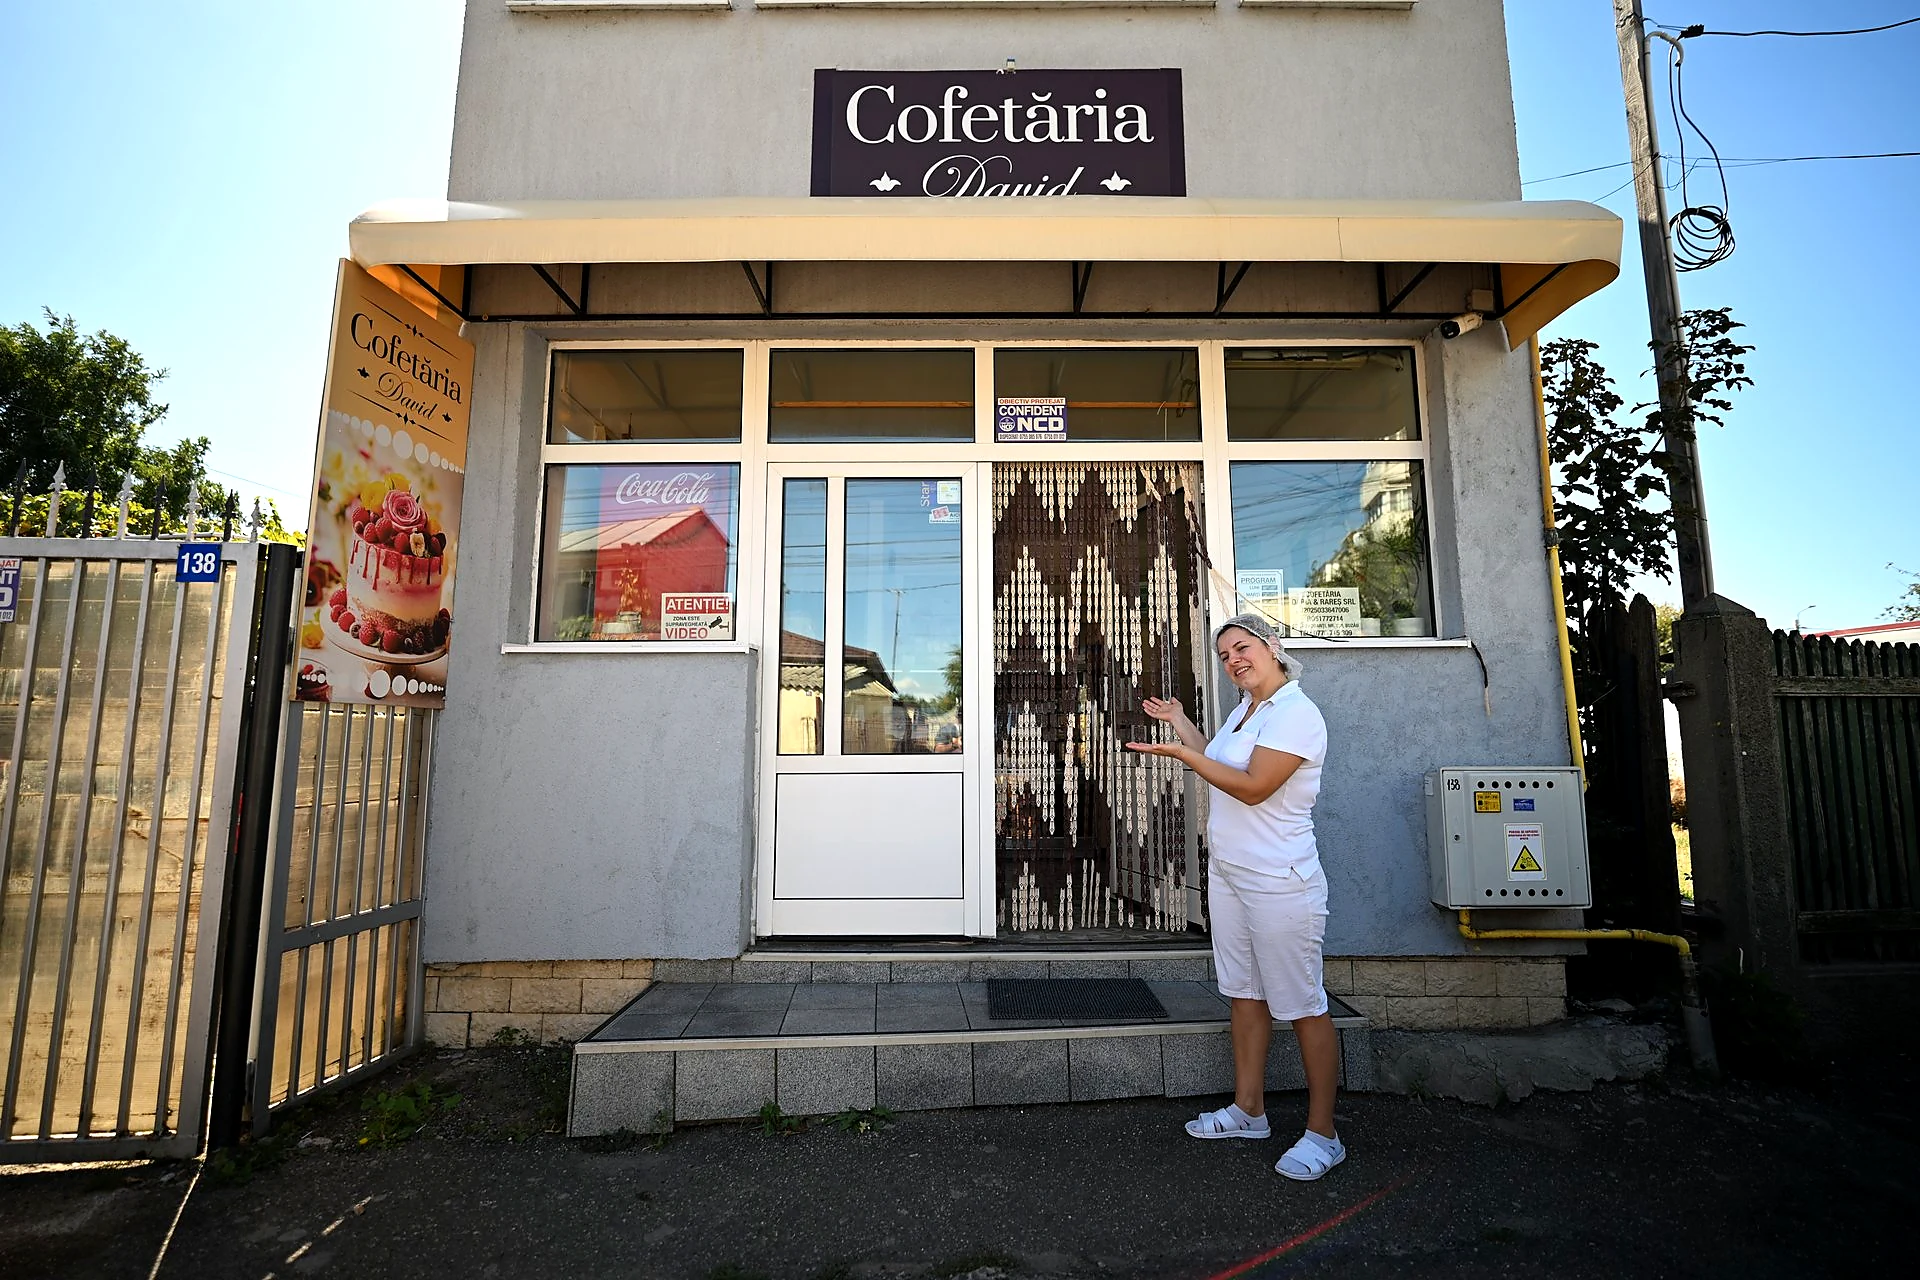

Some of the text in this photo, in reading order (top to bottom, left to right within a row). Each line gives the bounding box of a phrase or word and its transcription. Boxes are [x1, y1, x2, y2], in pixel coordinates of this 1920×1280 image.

[846, 84, 1154, 144] Cofetăria
[921, 154, 1086, 197] David
[350, 312, 462, 404] Cofetăria
[374, 372, 438, 421] David
[999, 405, 1065, 416] CONFIDENT
[1017, 417, 1064, 431] NCD
[615, 472, 716, 505] Coca-Cola
[181, 552, 216, 574] 138
[666, 598, 729, 613] ATENȚIE!
[665, 627, 708, 639] VIDEO
[1447, 778, 1461, 791] 138
